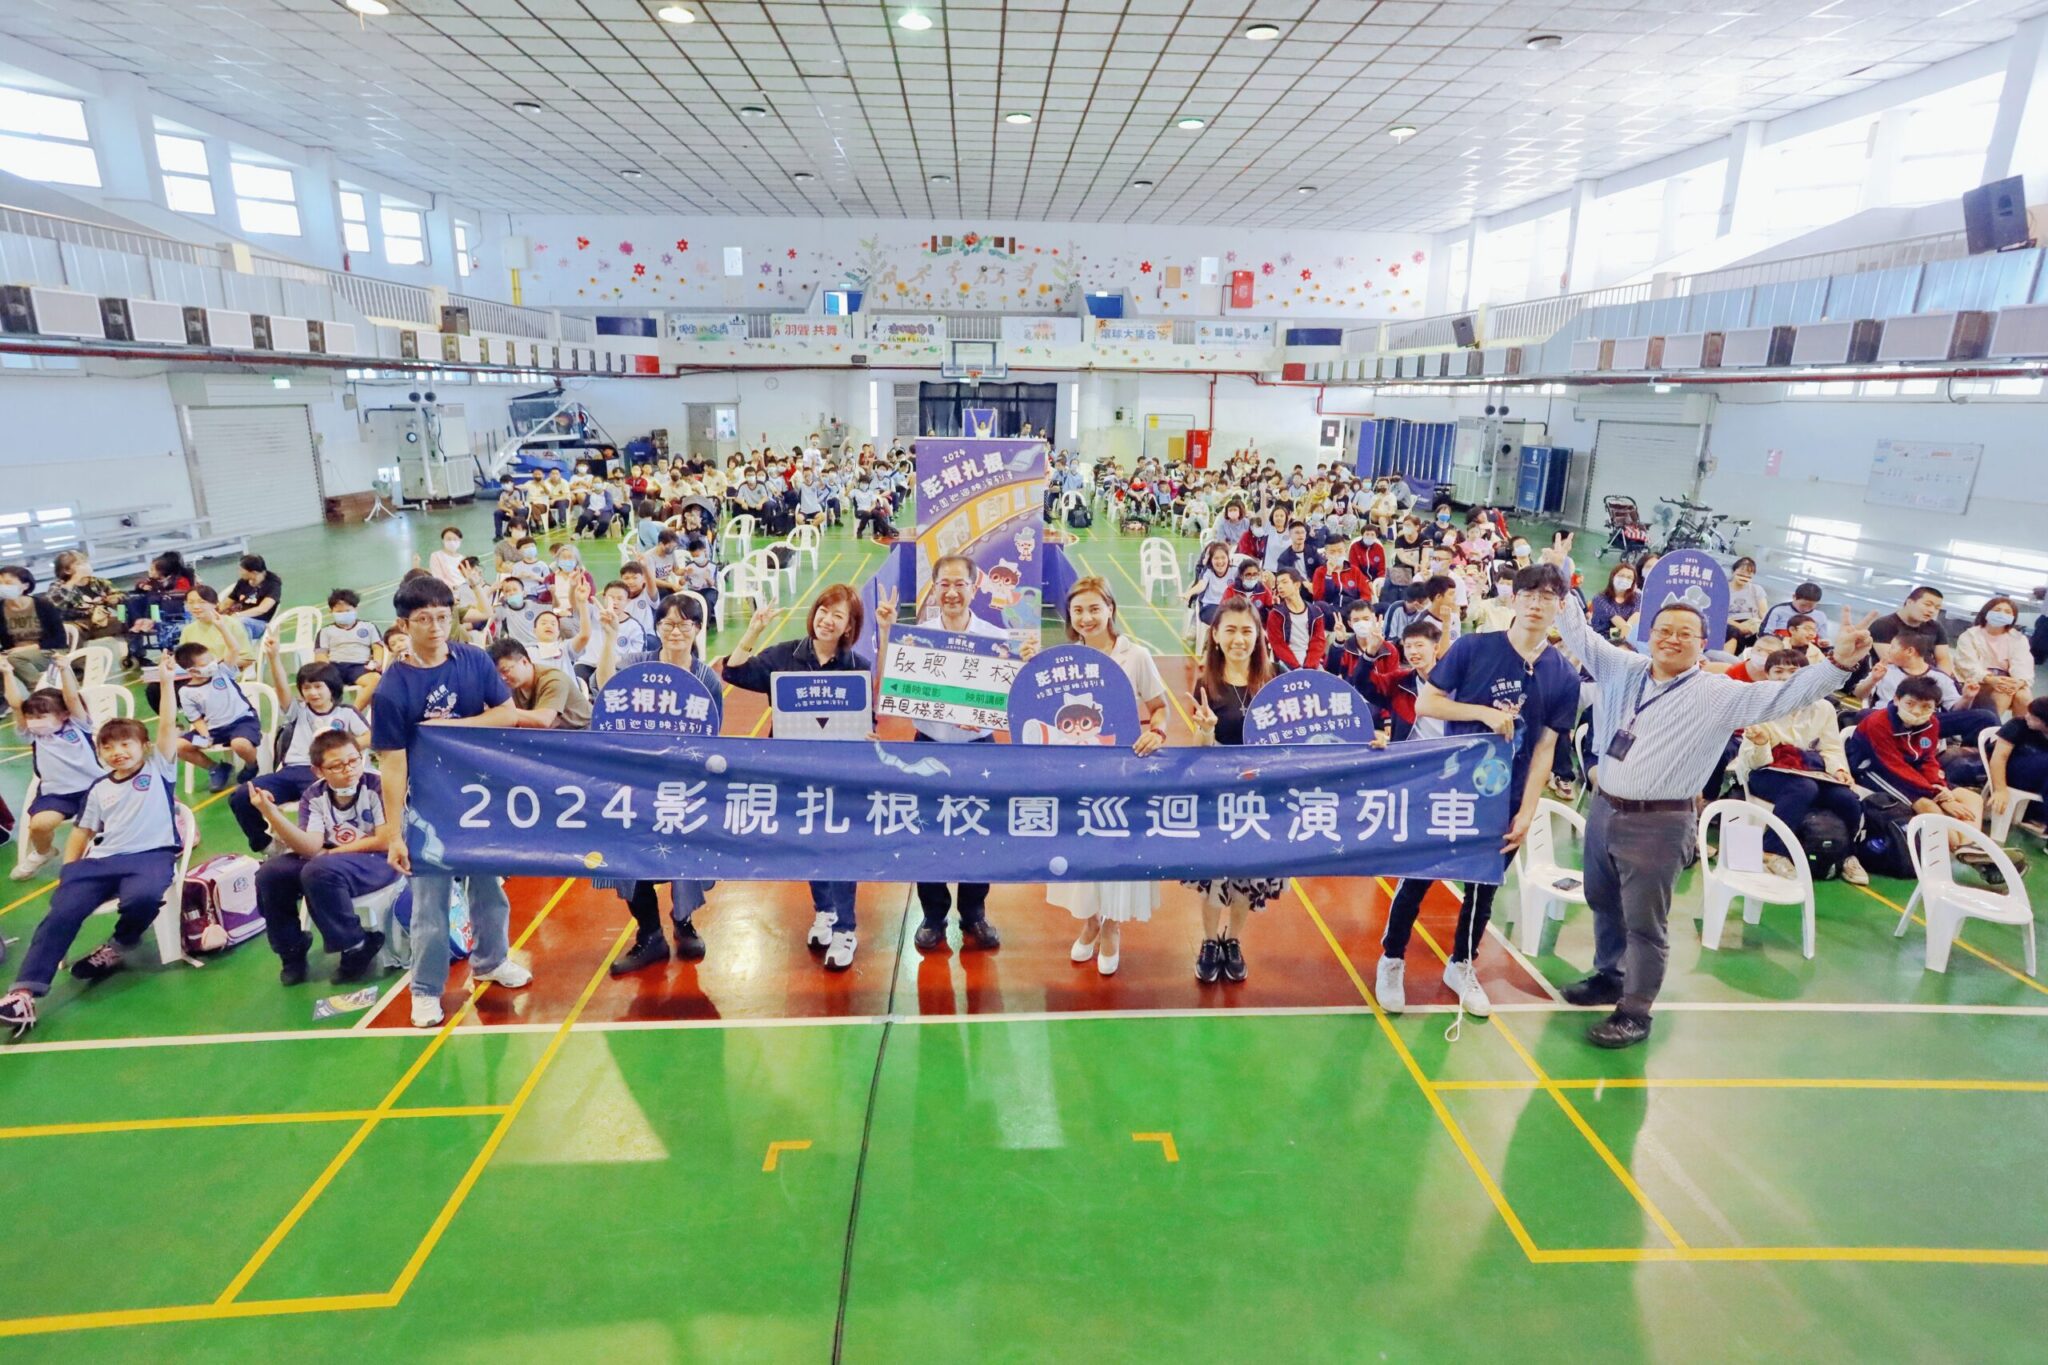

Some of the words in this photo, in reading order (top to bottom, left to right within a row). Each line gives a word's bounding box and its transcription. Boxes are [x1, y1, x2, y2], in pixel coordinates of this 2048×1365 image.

[942, 448, 966, 463] 2024
[920, 451, 1004, 499] 影視扎根
[642, 673, 672, 685] 2024
[1035, 663, 1099, 687] 影視扎根
[795, 686, 847, 699] 影視扎根
[902, 683, 941, 698] 播映電影
[1282, 680, 1312, 693] 2024
[603, 687, 711, 722] 影視扎根
[965, 691, 1005, 706] 映前講師
[972, 708, 1010, 729] 張淑
[1251, 691, 1353, 731] 影視扎根
[599, 718, 713, 737] 校園巡迴映演列車
[458, 780, 1480, 842] 2024影視扎根校園巡迴映演列車
